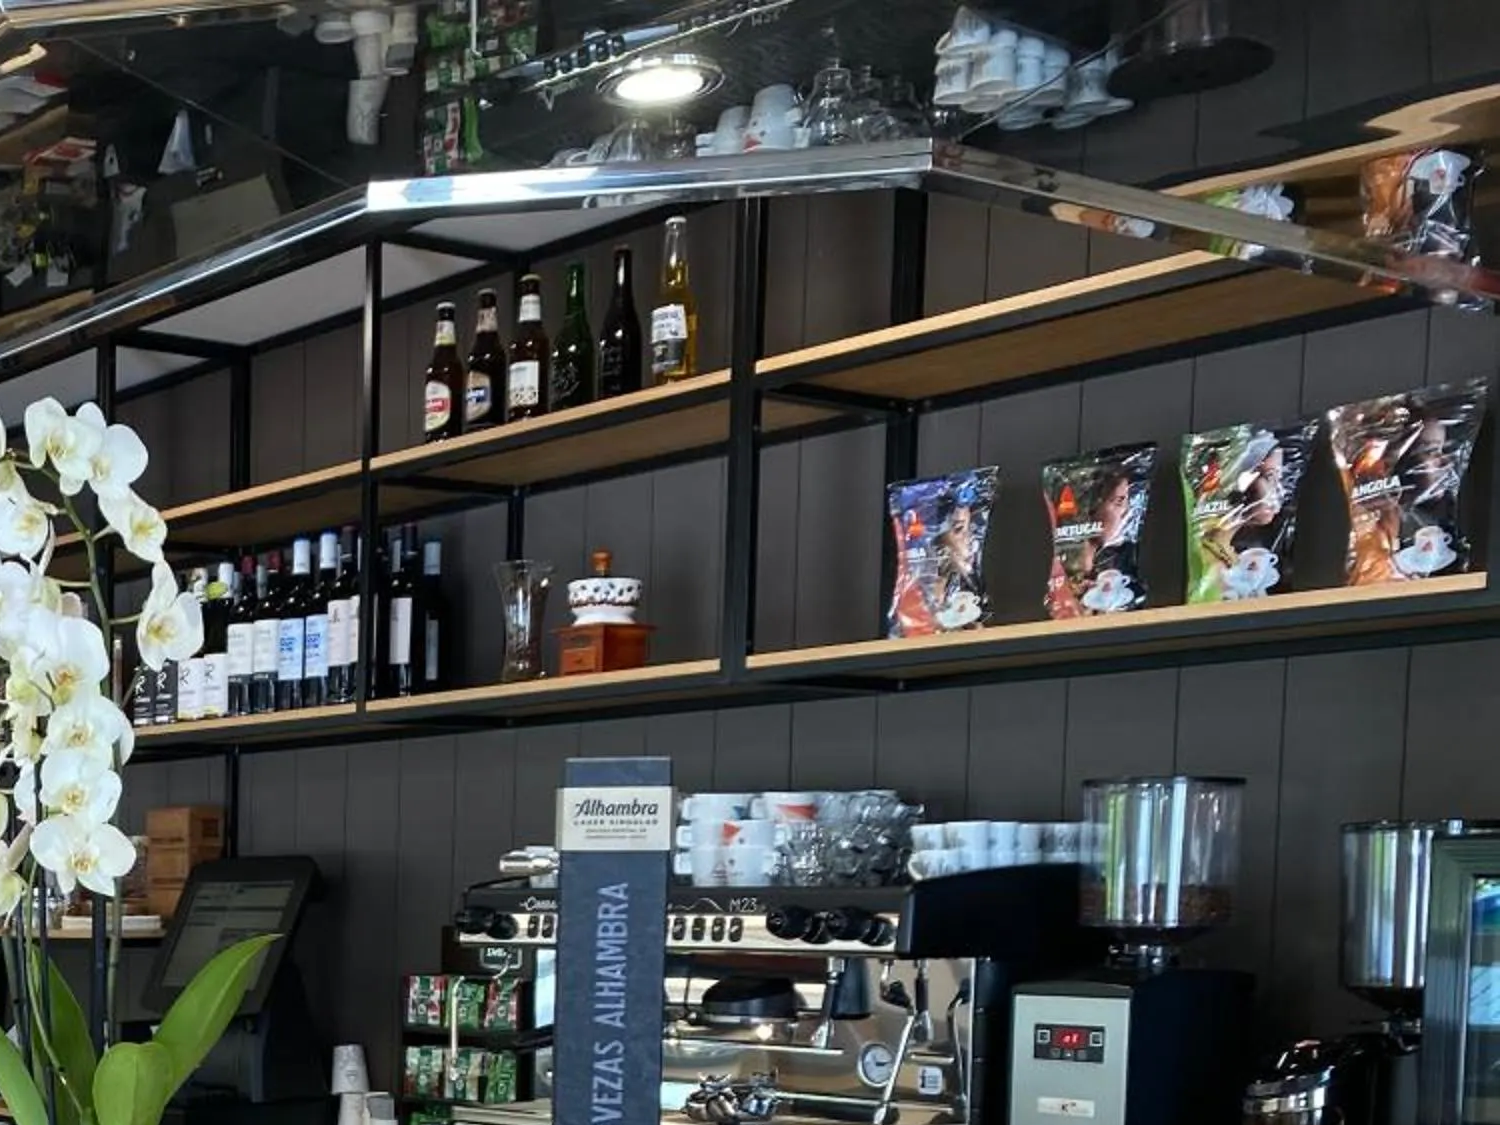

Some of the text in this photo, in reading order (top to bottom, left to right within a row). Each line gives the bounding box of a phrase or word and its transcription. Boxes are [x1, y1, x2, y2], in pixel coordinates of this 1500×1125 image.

[1351, 475, 1400, 498] ANGOLA
[575, 798, 659, 818] Alhambra
[729, 897, 758, 913] M23
[595, 882, 630, 1029] ALHAMBRA
